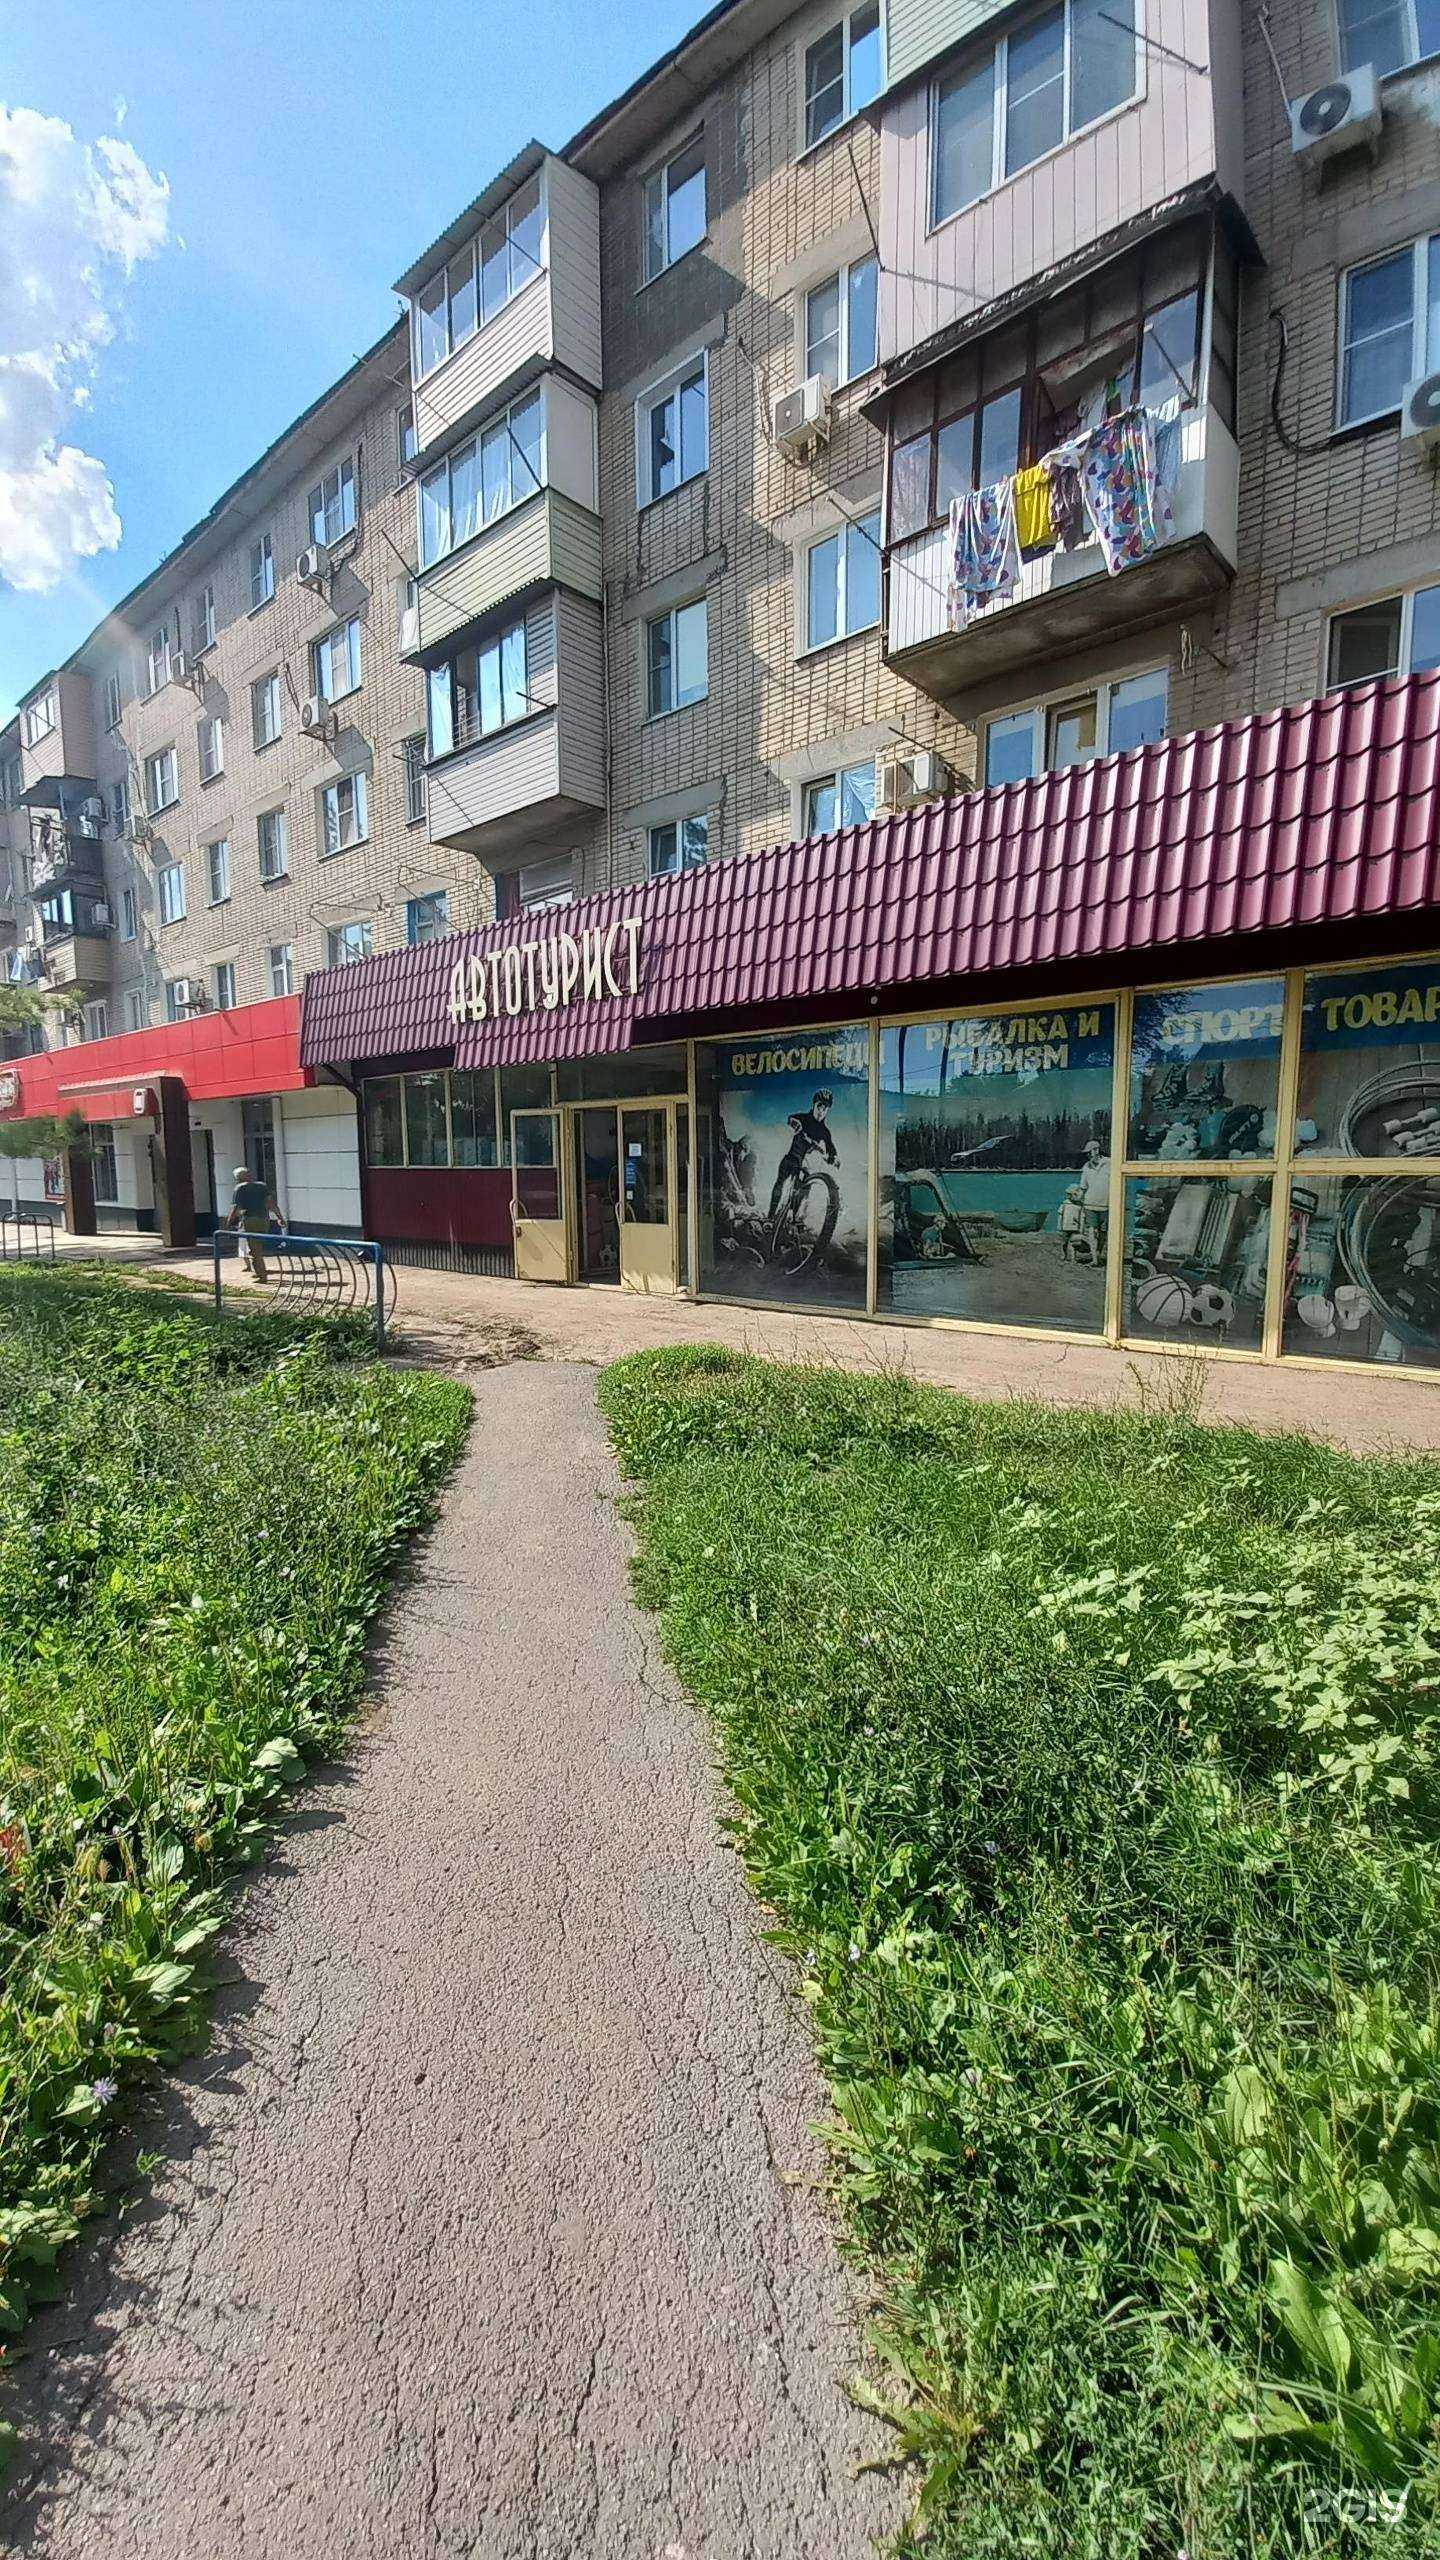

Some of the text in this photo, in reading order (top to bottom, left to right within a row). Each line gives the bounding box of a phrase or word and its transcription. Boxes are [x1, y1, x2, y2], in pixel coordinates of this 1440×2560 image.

[447, 917, 643, 1024] АВТОТУРИСТ
[926, 1011, 1100, 1050] РЫБАЛКА И
[949, 1044, 1069, 1076] ТУРИЗМ
